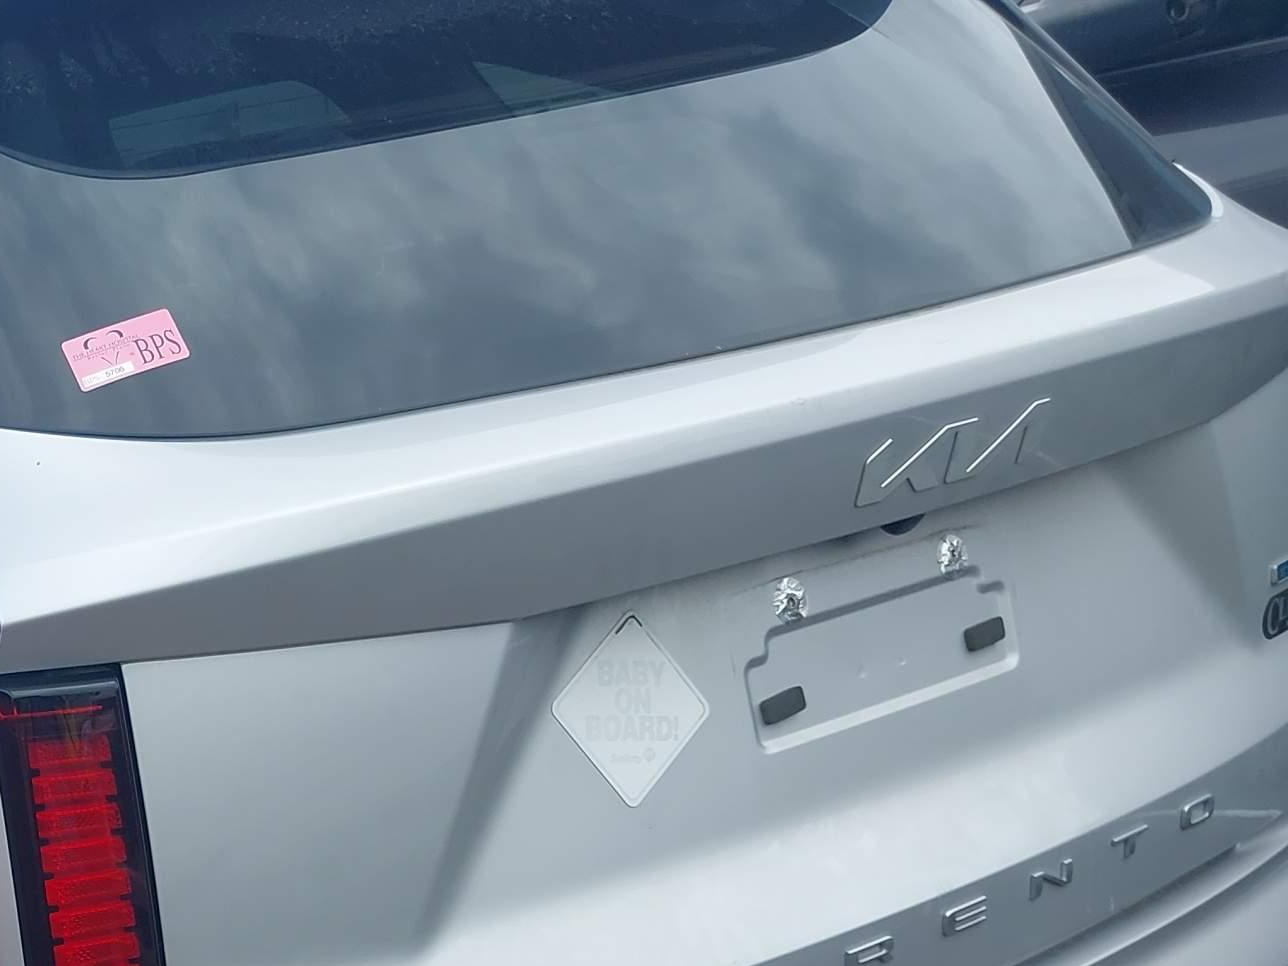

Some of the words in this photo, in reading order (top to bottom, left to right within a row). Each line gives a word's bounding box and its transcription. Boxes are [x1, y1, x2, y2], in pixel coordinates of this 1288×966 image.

[134, 329, 182, 364] BPS
[597, 660, 664, 687] BABY
[614, 688, 651, 714] ON
[584, 715, 680, 742] BOARD!
